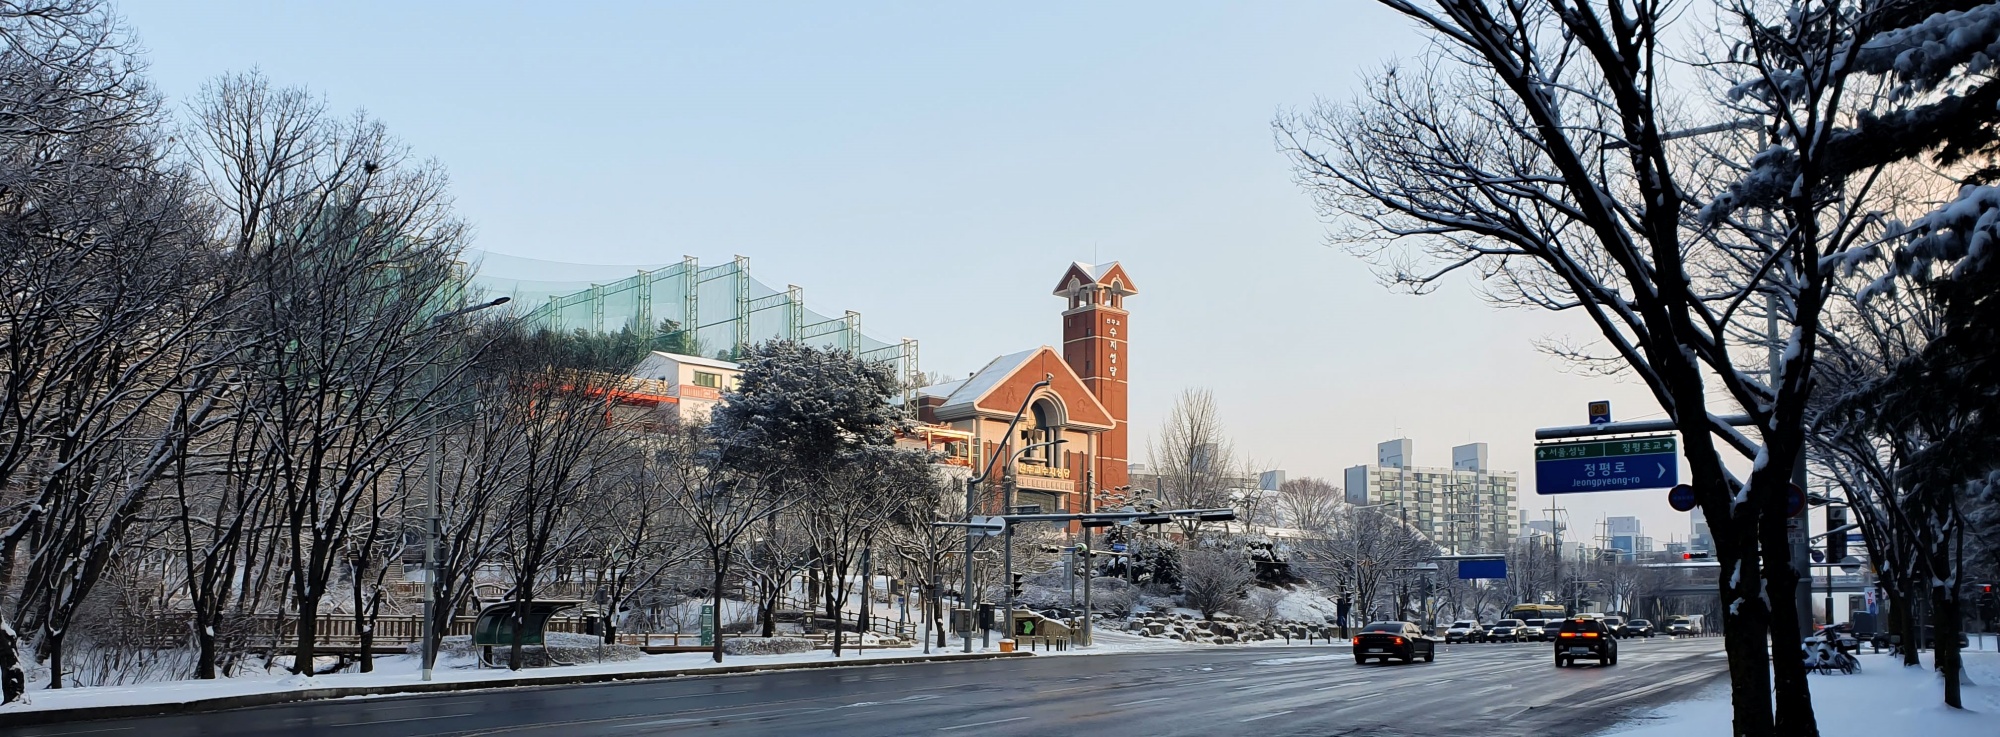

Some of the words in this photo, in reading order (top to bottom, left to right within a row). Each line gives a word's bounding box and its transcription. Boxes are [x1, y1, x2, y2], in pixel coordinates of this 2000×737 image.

[1622, 441, 1661, 453] 정평초교
[1584, 462, 1627, 477] 정평로
[1572, 476, 1641, 488] Jeongpyeong-ro
